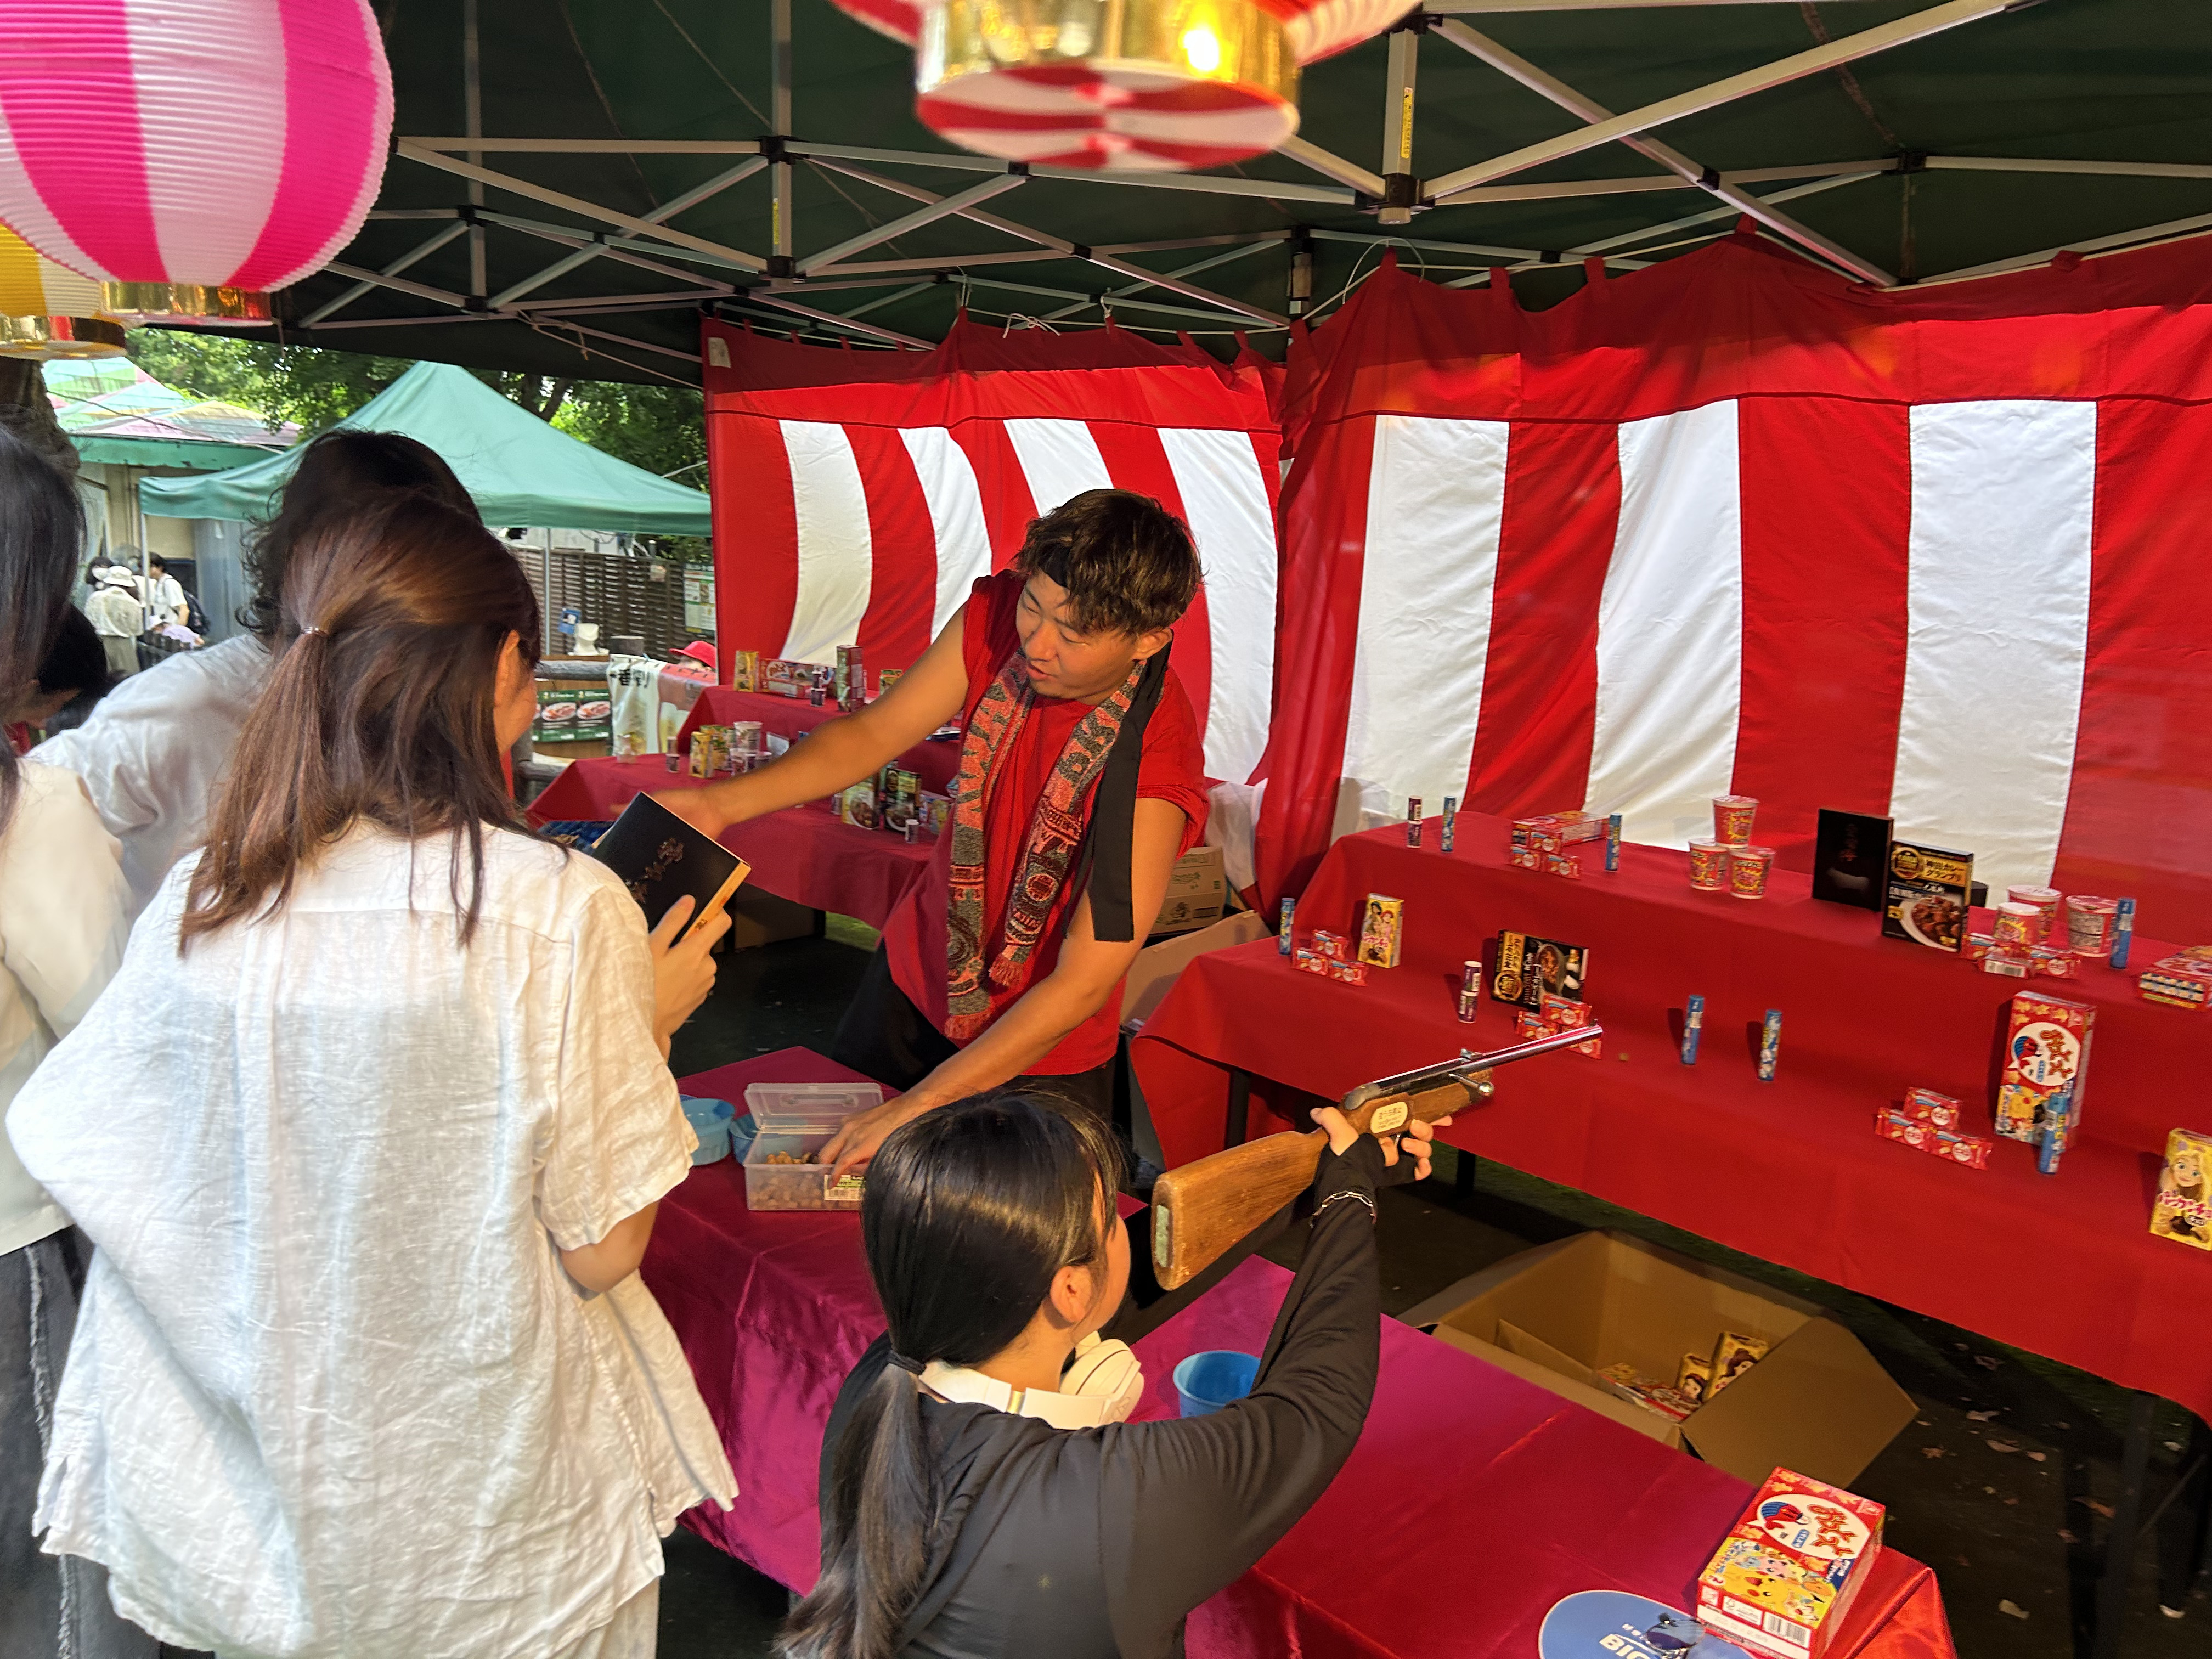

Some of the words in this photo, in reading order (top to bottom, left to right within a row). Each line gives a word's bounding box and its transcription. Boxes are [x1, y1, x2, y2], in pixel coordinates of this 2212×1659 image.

[2040, 1029, 2074, 1079] おっとっと
[1807, 1504, 1858, 1557] おっとっと
